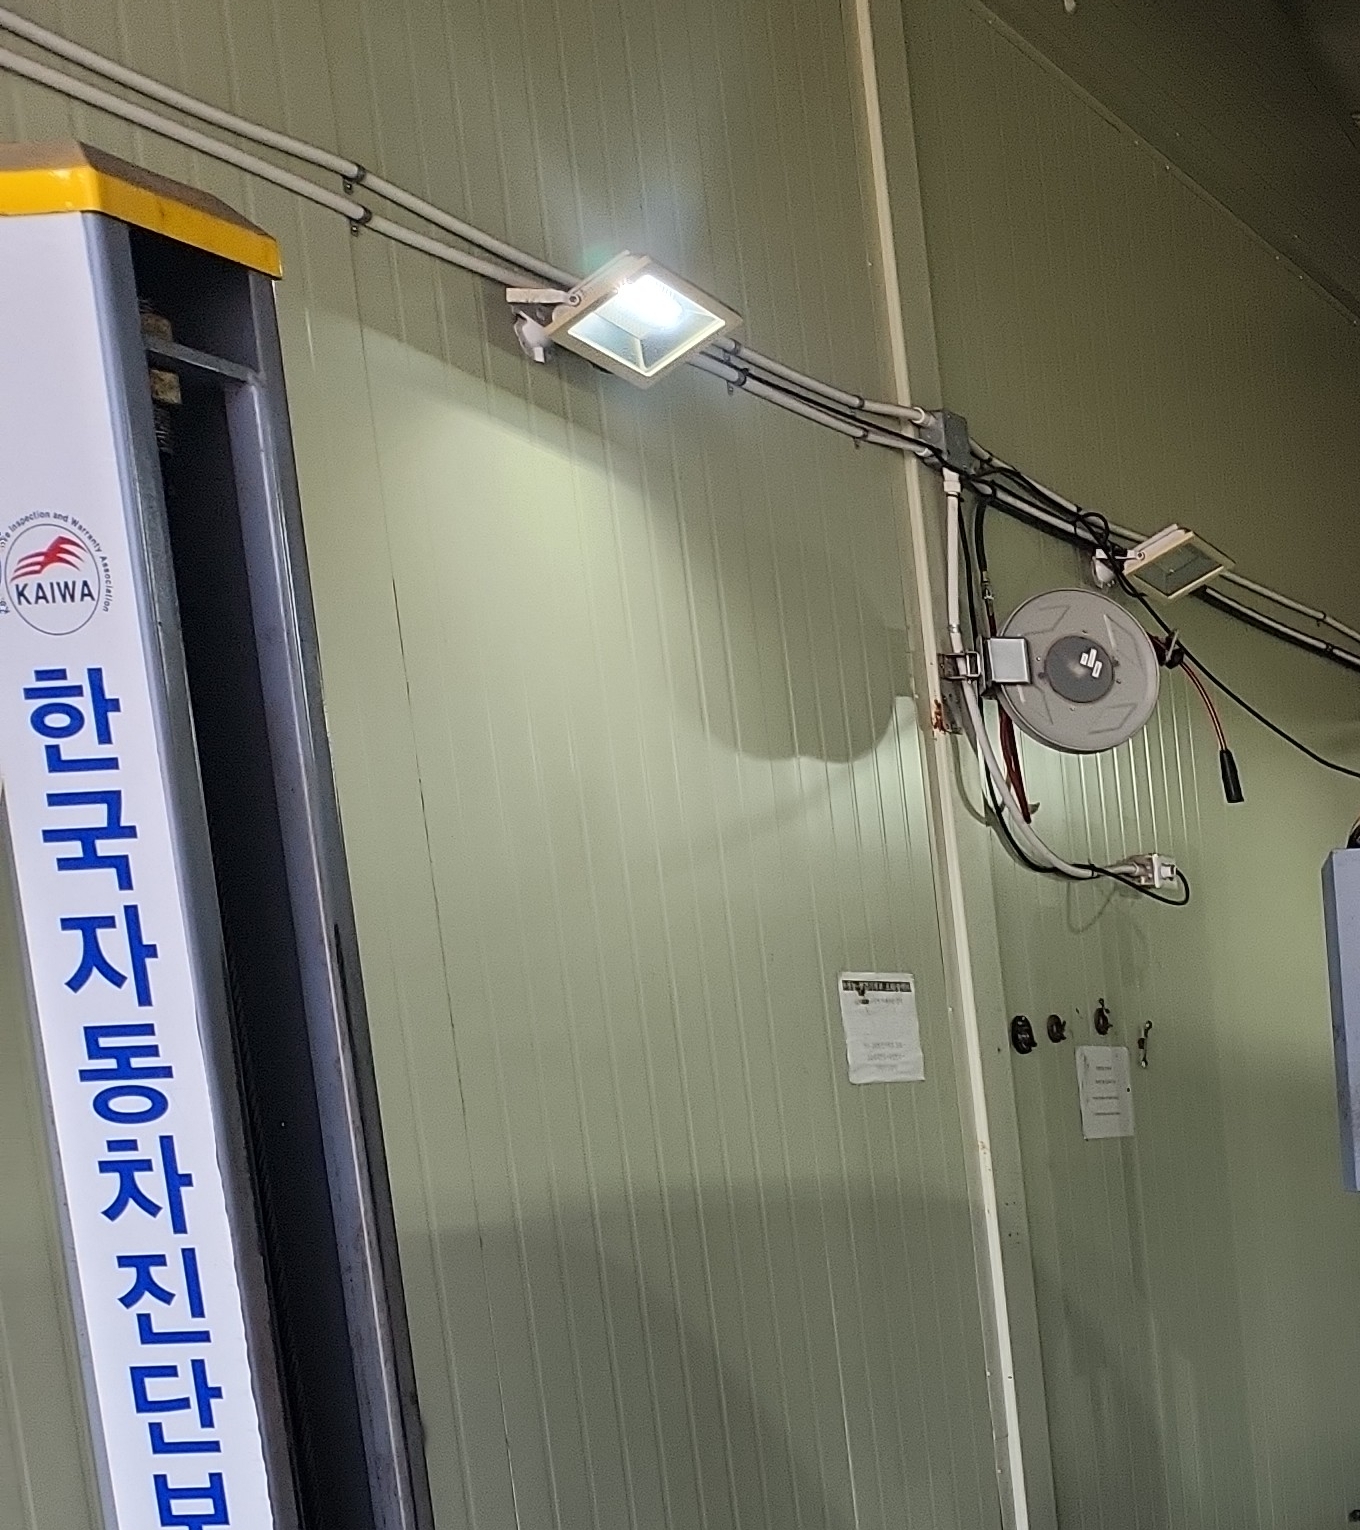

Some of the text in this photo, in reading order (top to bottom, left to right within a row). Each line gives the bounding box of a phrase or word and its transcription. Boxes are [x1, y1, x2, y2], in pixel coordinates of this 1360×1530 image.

[8, 511, 114, 612] Inspection and Warranty Association
[15, 580, 96, 606] KAIWA
